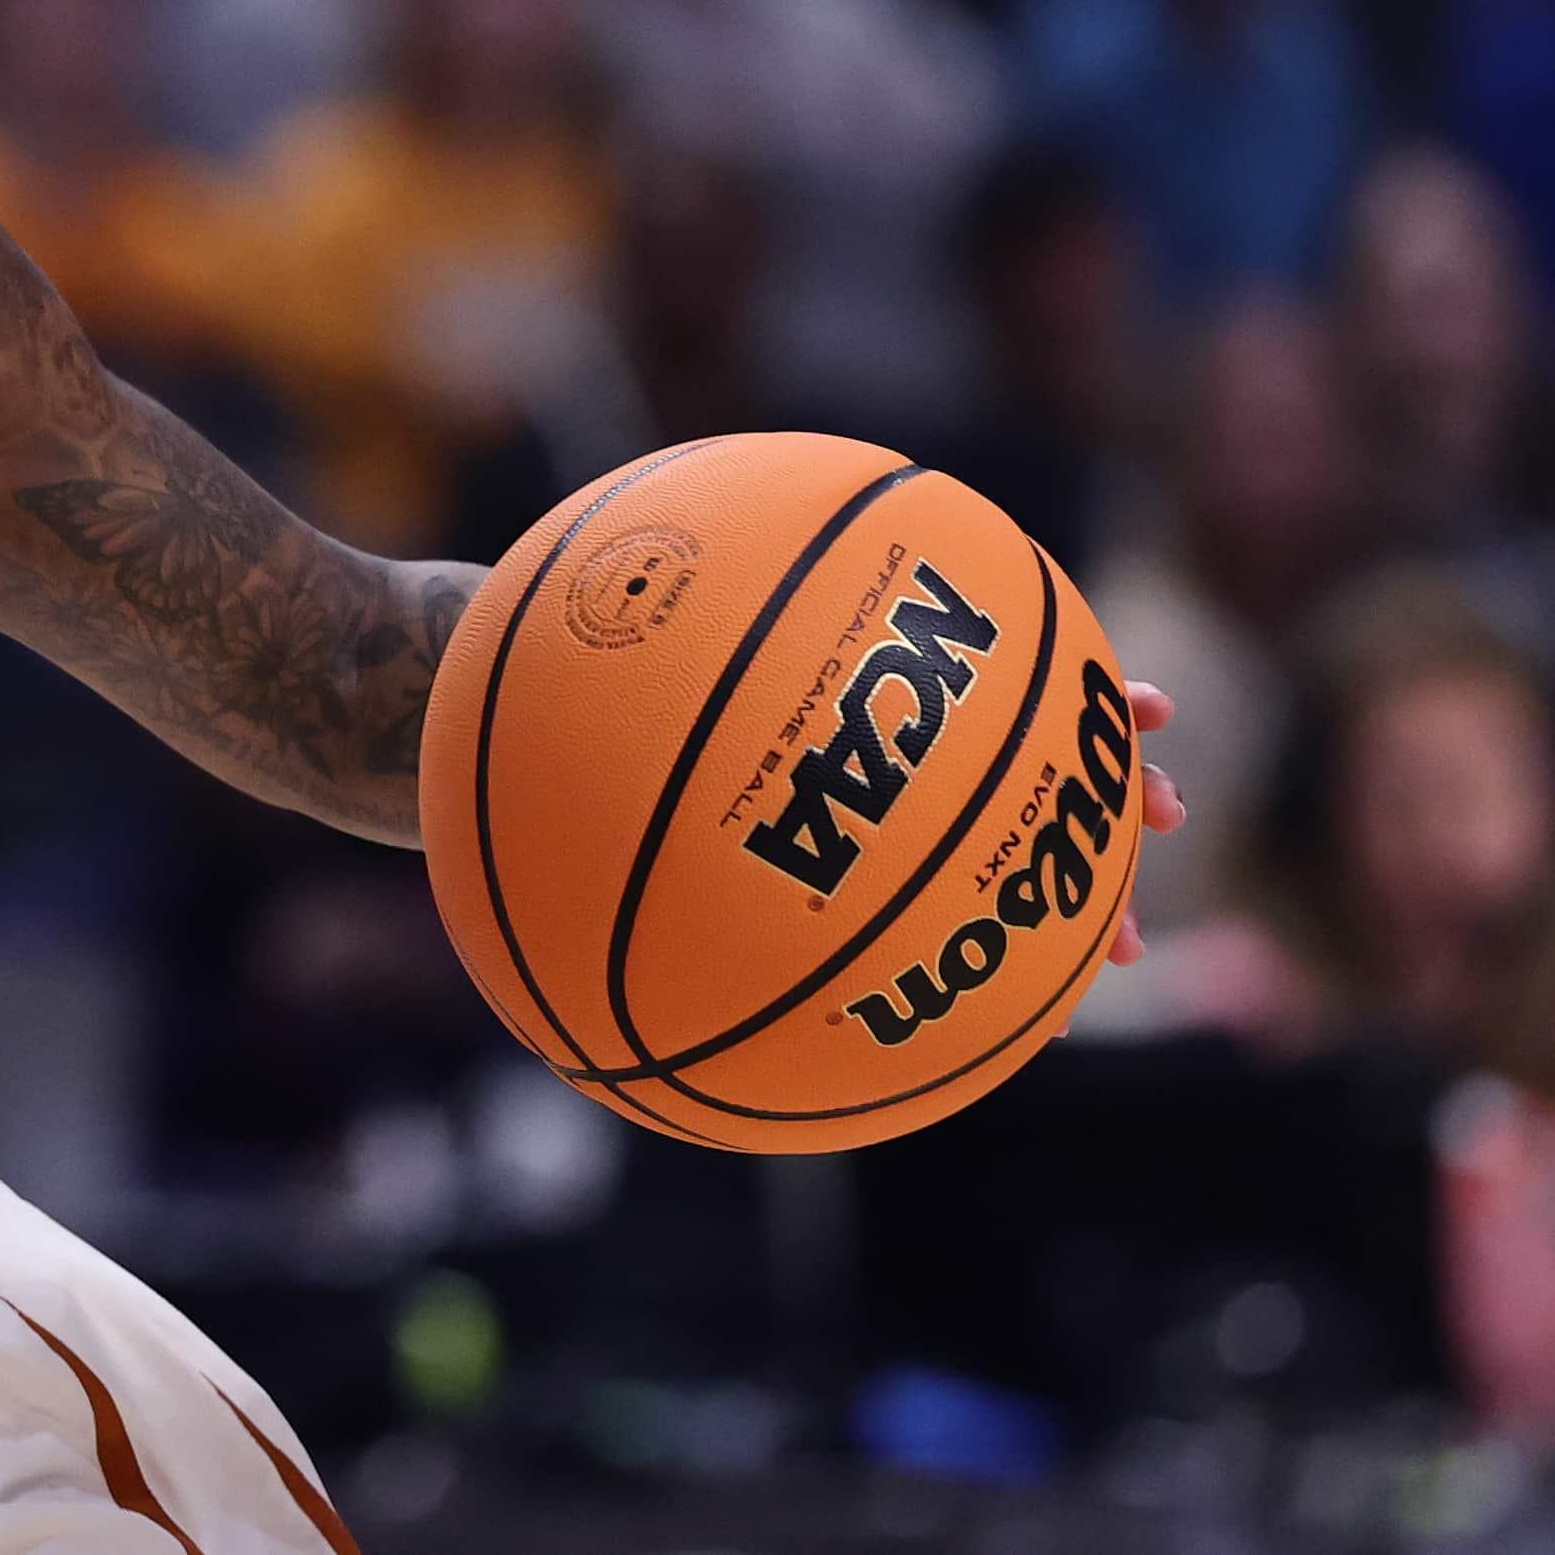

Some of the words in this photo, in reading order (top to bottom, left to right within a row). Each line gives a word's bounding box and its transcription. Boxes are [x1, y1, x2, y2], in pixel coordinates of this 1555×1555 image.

[837, 542, 907, 650] OFFICIAL
[742, 557, 1001, 898] NCAA
[778, 658, 842, 747] GAME
[718, 749, 783, 829] BALL
[1020, 761, 1058, 828] EVO
[842, 658, 1131, 1047] Wilson
[974, 830, 1022, 894] NXT
